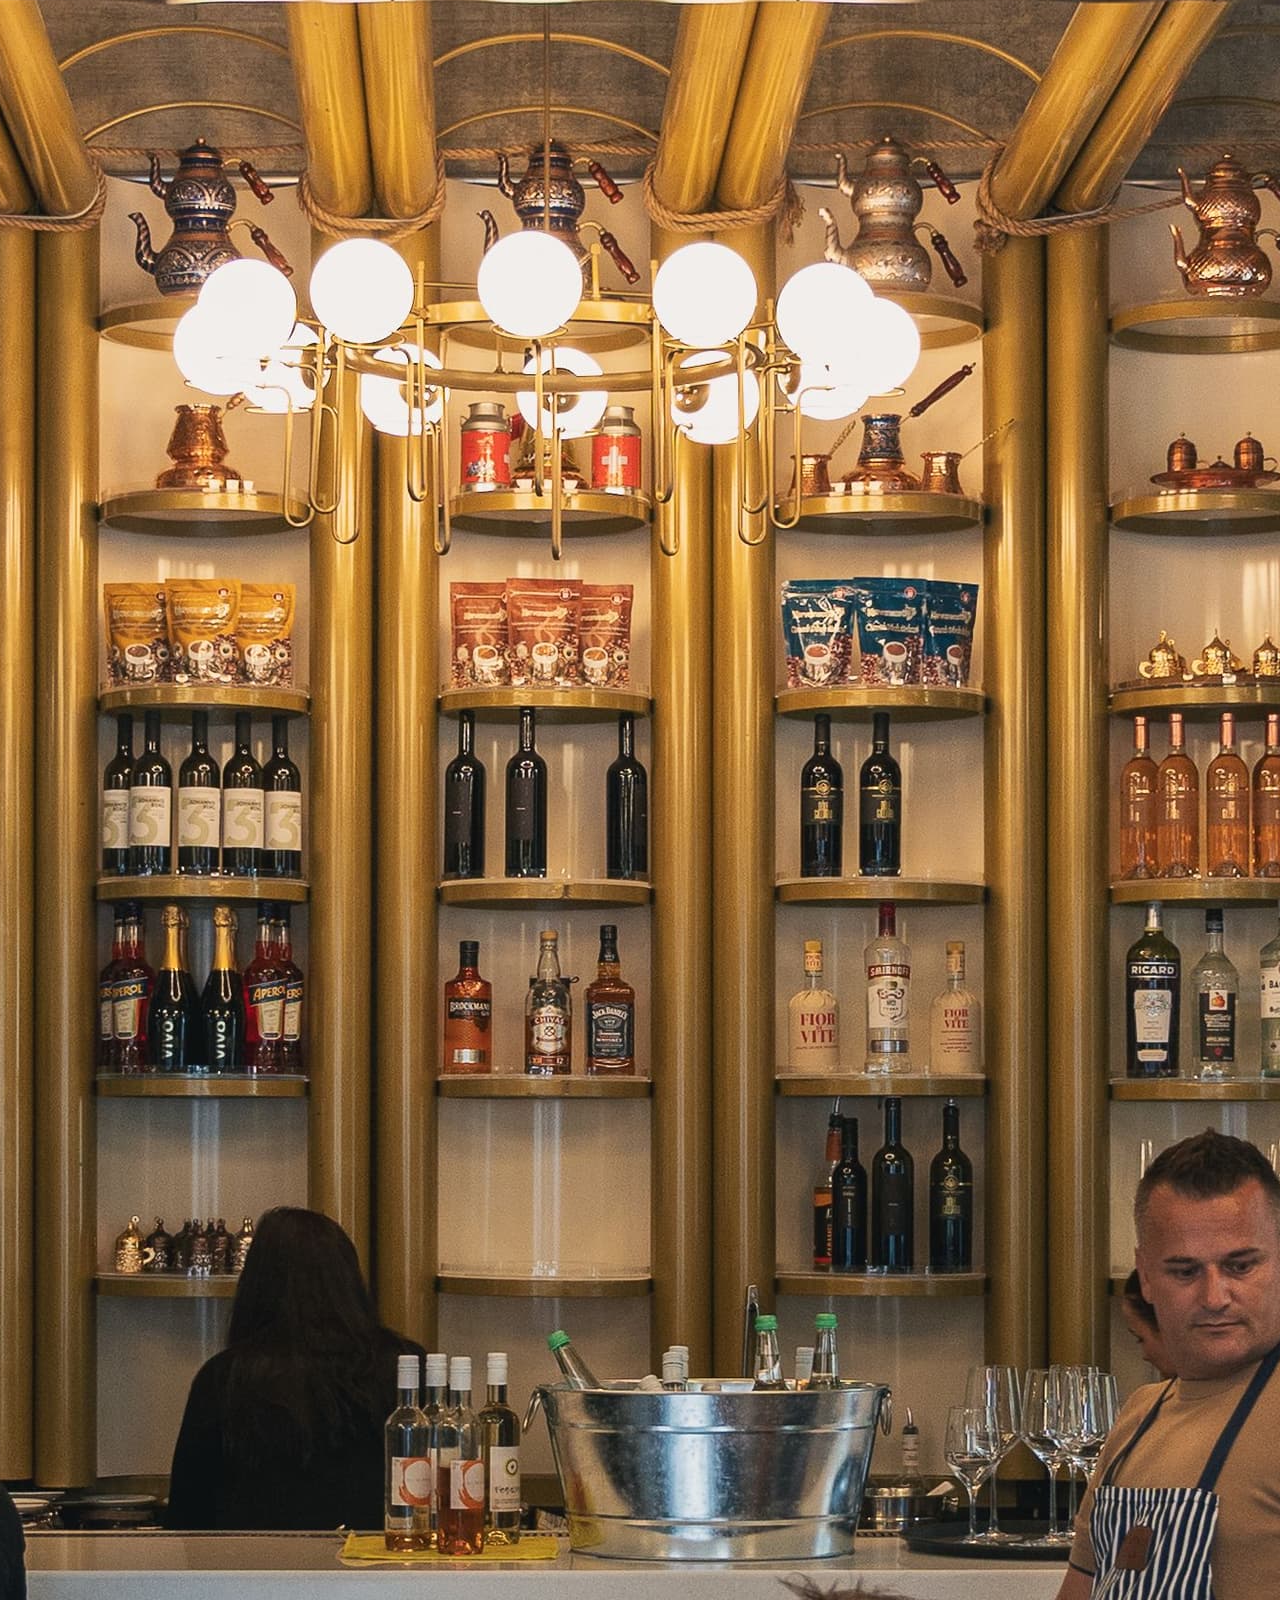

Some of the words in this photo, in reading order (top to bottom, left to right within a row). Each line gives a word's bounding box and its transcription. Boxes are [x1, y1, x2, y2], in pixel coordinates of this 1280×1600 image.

[870, 965, 909, 977] SMIRNOFF
[1131, 965, 1175, 975] RICARD
[592, 1008, 606, 1020] JACK
[943, 1008, 969, 1018] FIOR
[534, 1015, 565, 1025] CHIVAS
[800, 1013, 836, 1026] FIOR
[944, 1019, 969, 1029] VITE
[162, 1020, 174, 1060] VIVO
[216, 1020, 226, 1060] VIVO
